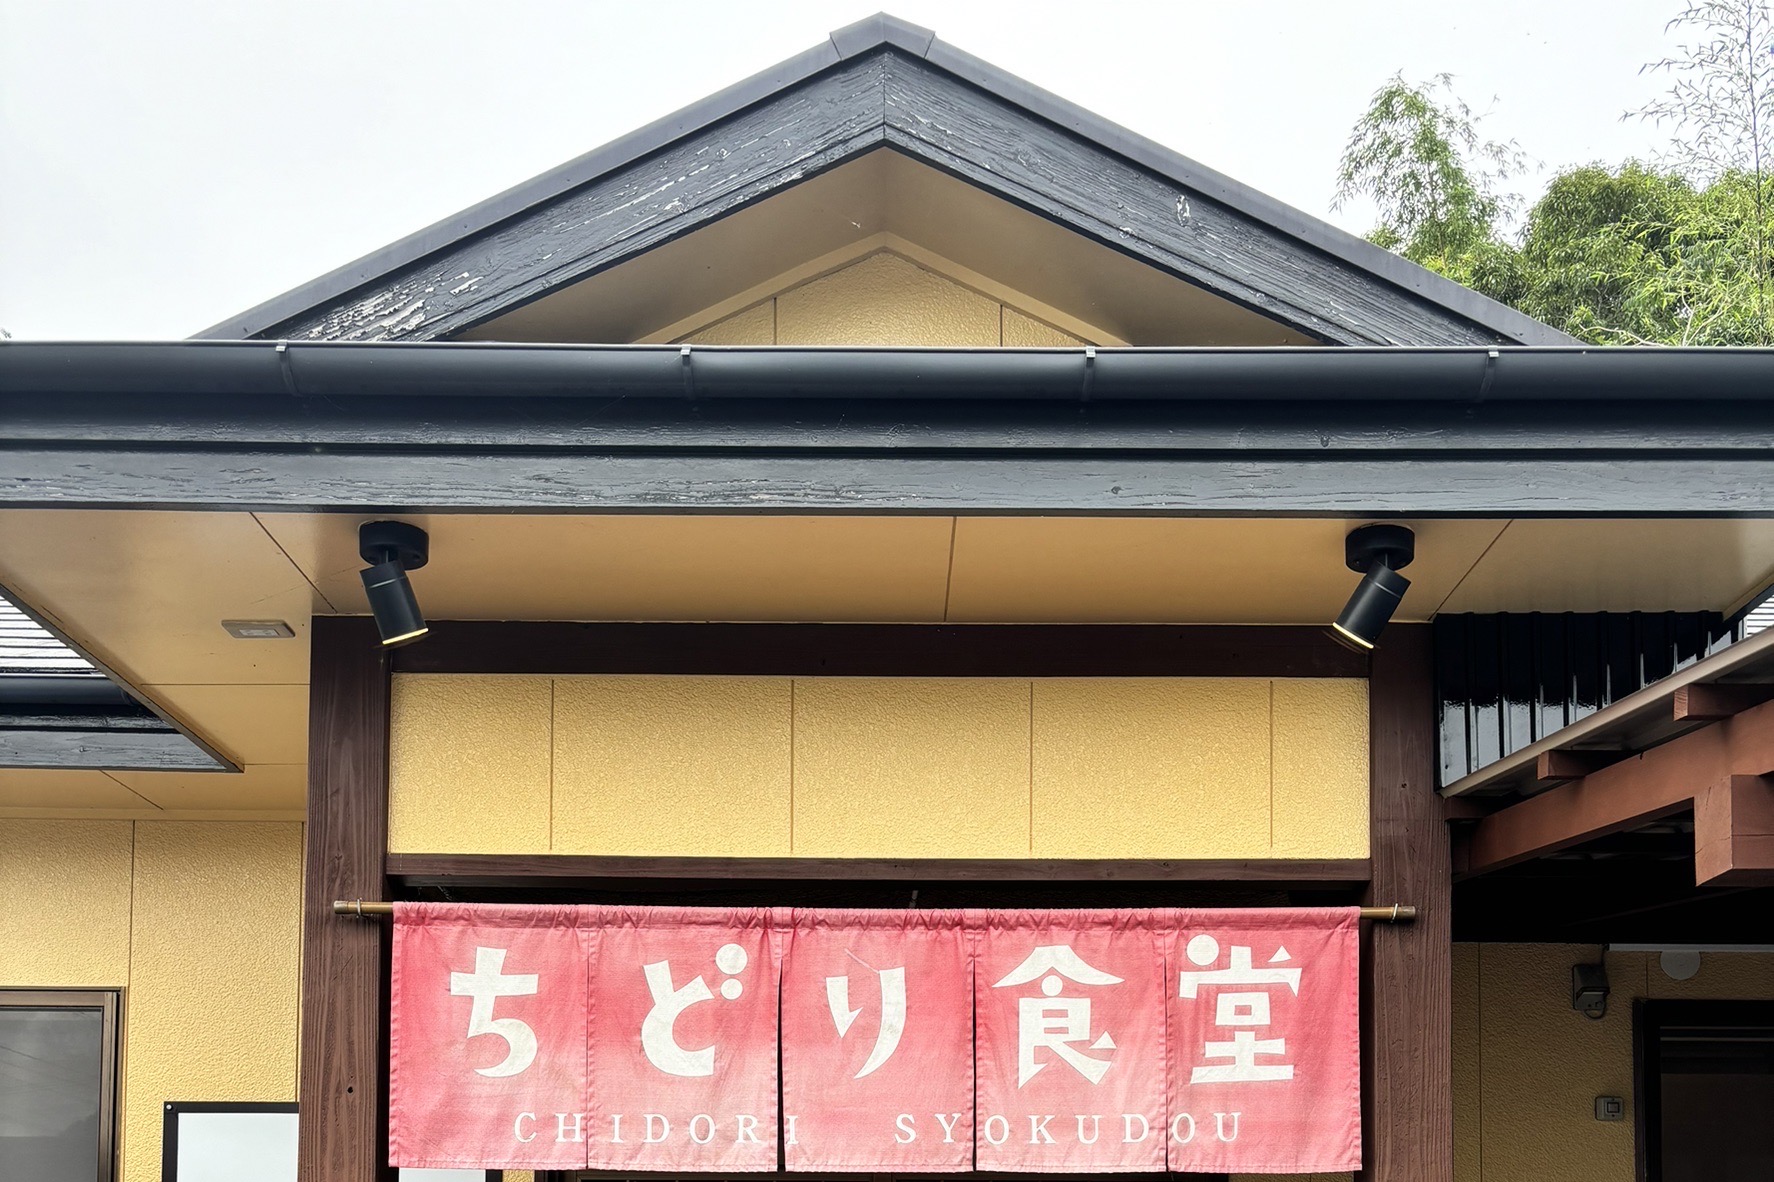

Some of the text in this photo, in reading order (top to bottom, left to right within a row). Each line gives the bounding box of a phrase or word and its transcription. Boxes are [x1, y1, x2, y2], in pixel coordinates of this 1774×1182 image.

[450, 934, 1303, 1088] ちどり食堂
[514, 1111, 1243, 1146] CHIDORI SYOKUDOU
